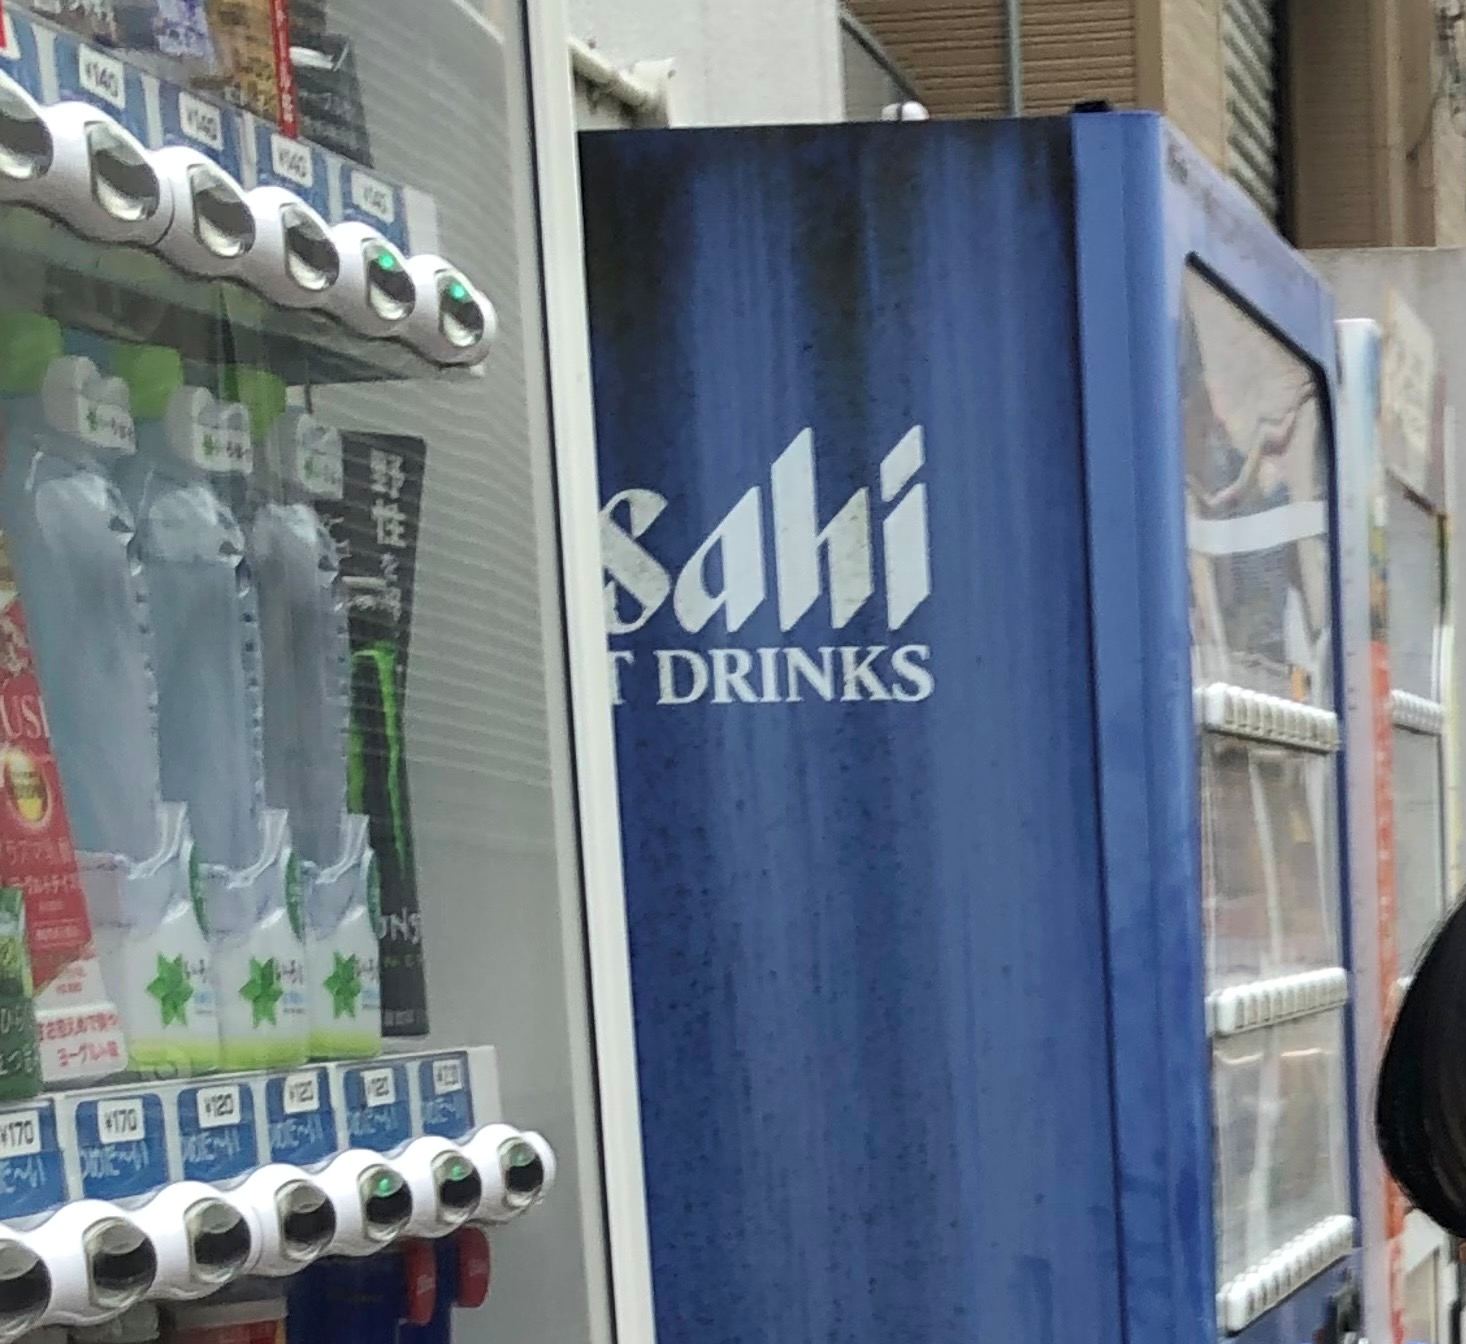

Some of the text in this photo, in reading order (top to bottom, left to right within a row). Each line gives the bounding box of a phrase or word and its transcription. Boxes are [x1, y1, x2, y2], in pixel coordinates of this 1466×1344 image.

[653, 644, 935, 706] DRINKS
[204, 1092, 235, 1118] ¥120
[104, 1108, 139, 1134] ¥170
